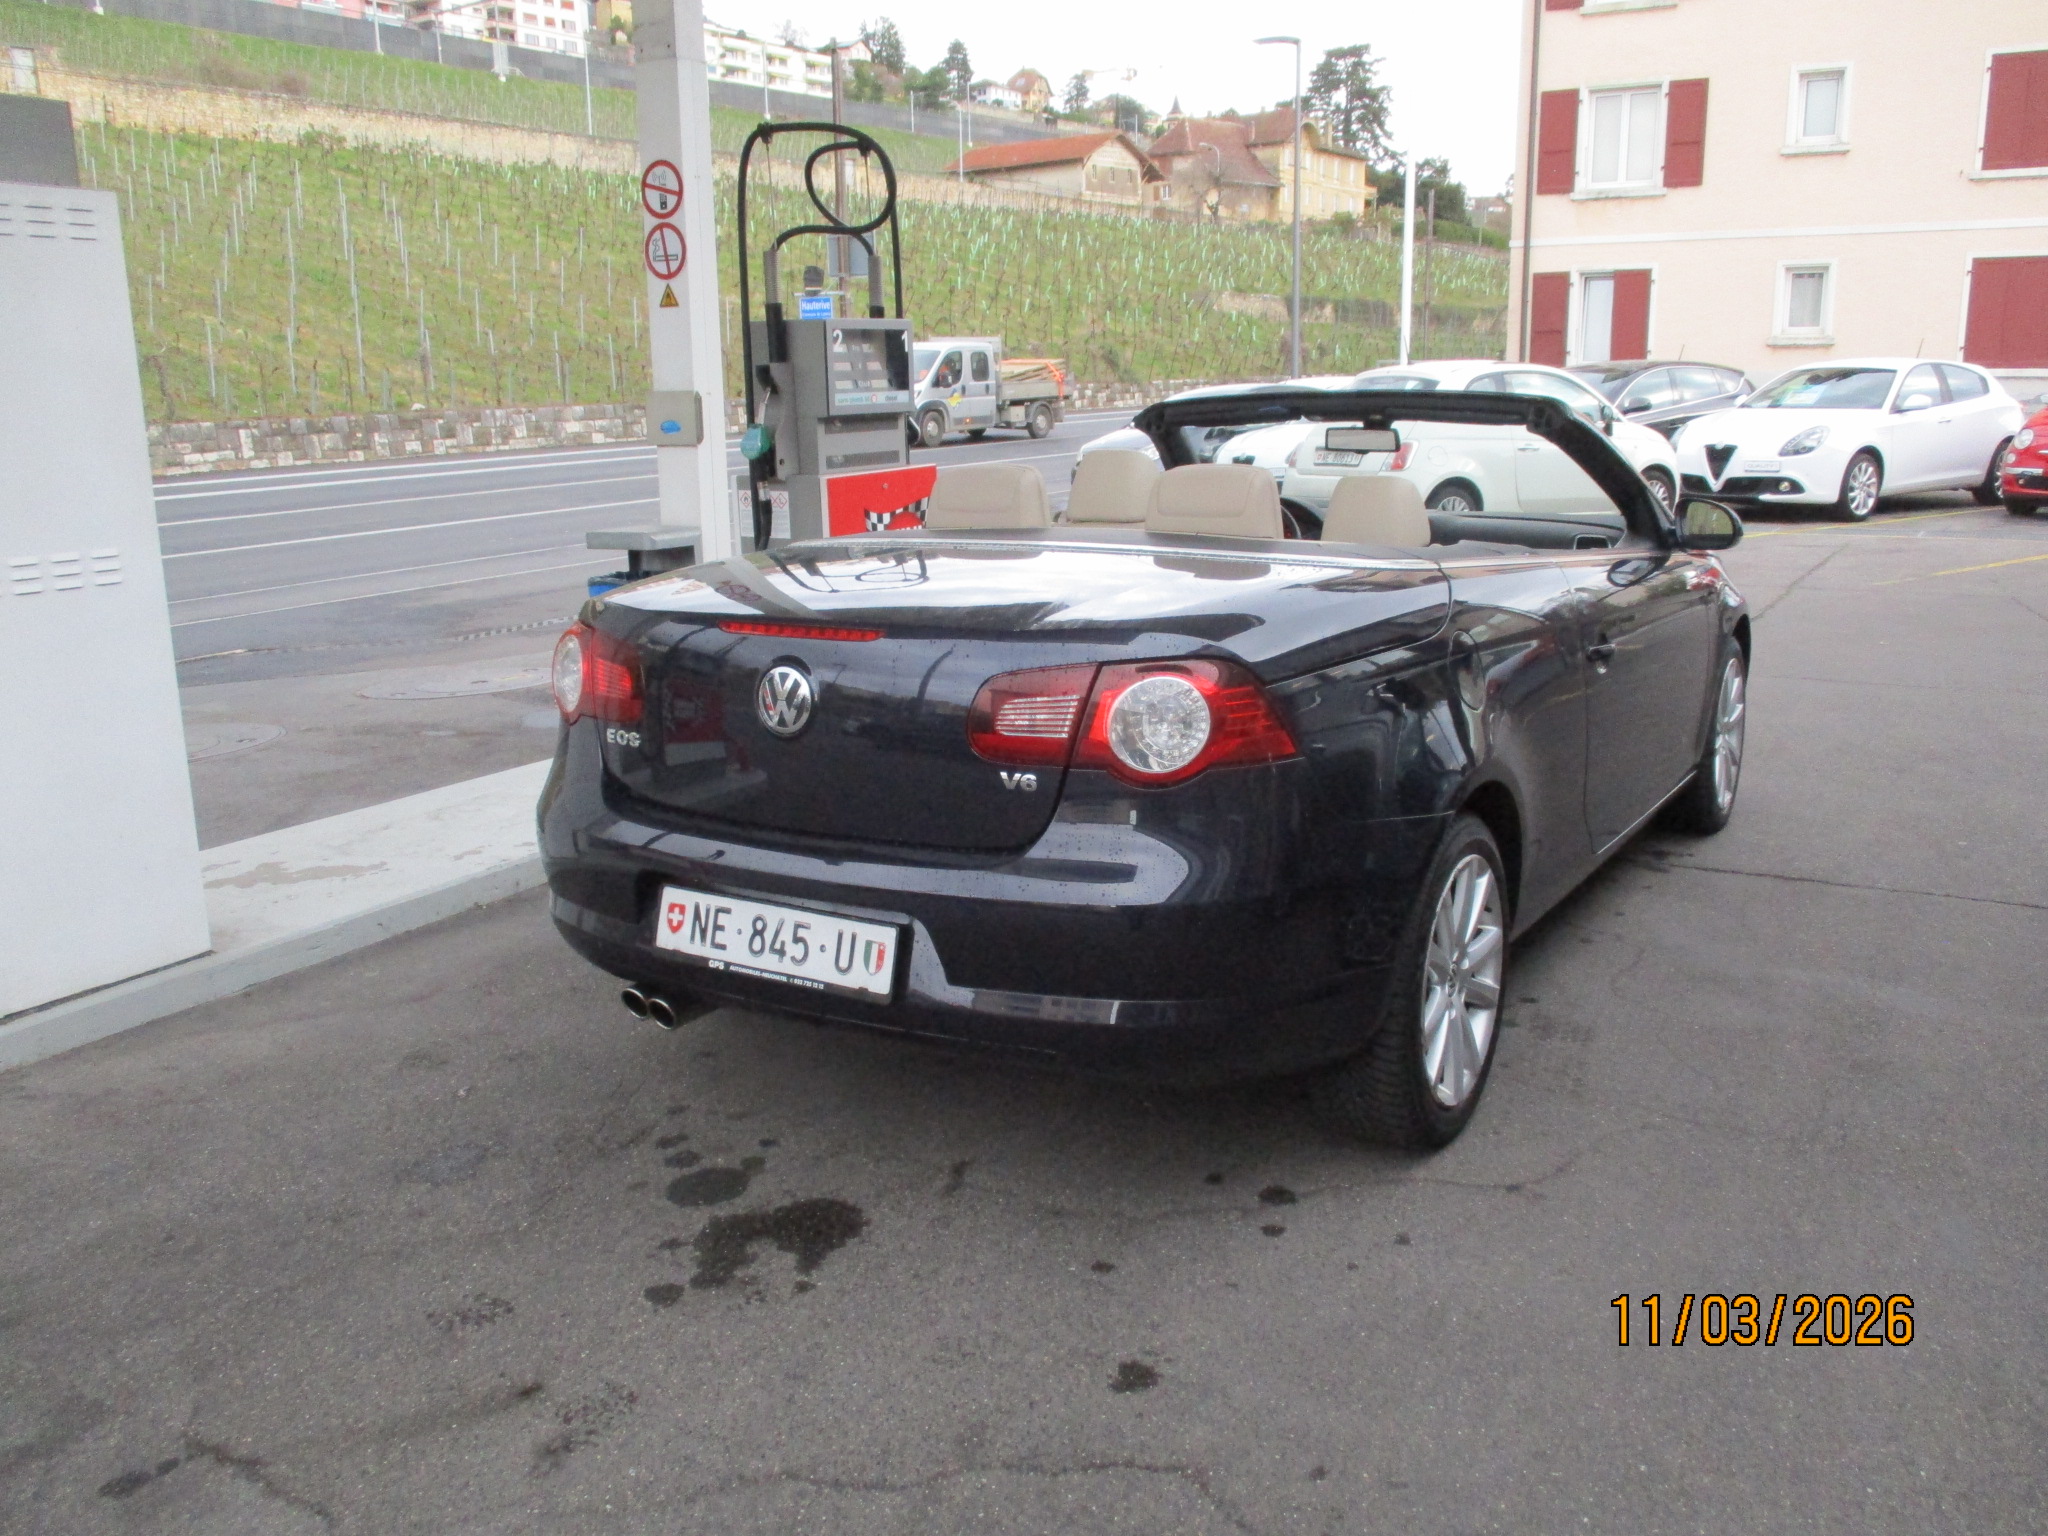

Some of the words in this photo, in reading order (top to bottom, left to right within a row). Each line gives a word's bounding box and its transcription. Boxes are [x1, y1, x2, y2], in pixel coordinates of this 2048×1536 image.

[801, 300, 831, 310] Hauterive
[833, 329, 843, 353] 2
[901, 330, 909, 353] 1
[606, 728, 641, 748] EOS
[1000, 771, 1038, 792] V6
[708, 959, 725, 970] GPS
